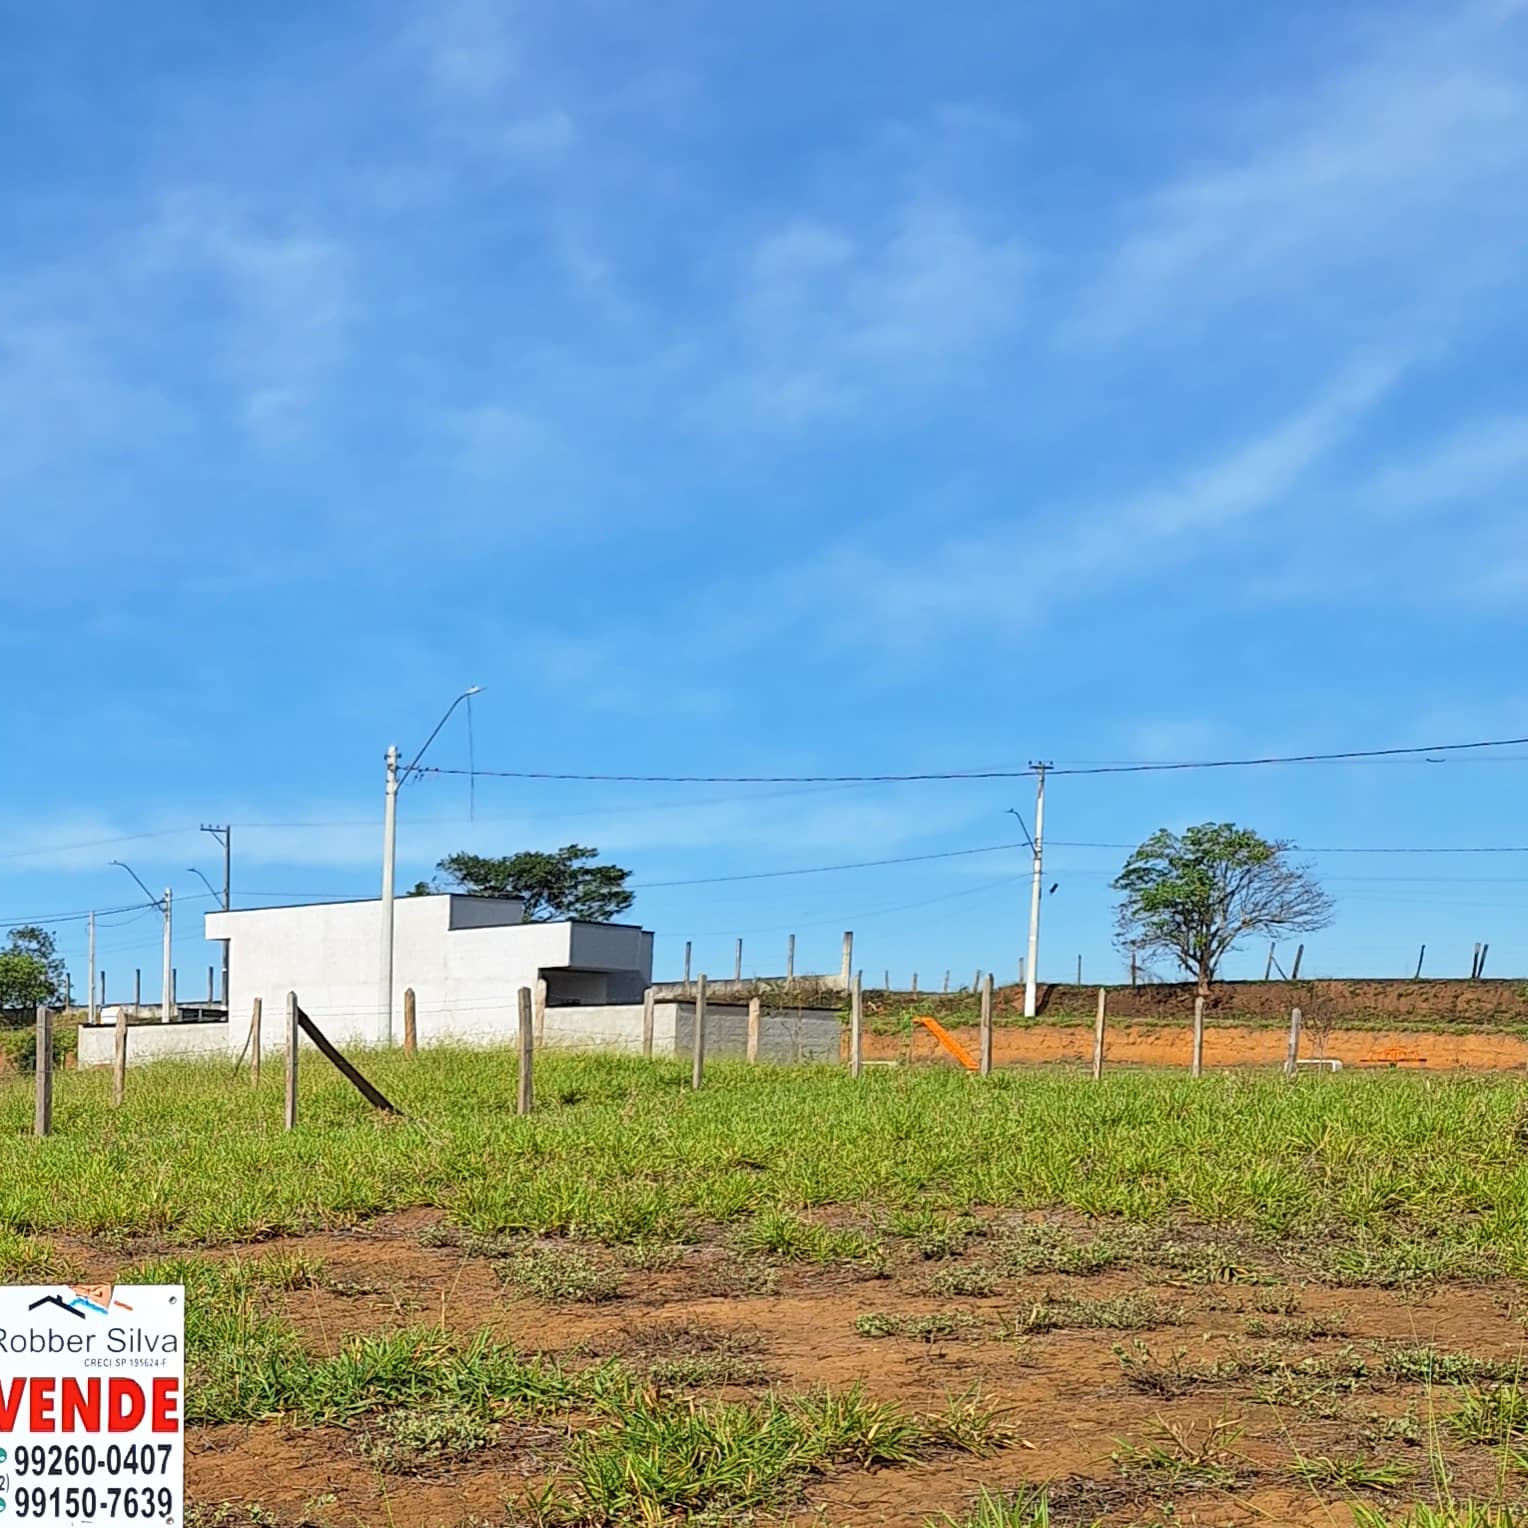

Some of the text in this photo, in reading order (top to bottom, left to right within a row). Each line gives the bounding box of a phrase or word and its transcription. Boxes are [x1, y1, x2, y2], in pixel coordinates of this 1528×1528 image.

[106, 1328, 178, 1353] Silva
[84, 1358, 112, 1367] CRECI
[115, 1358, 127, 1367] SP
[14, 1444, 172, 1476] 99260-0407
[14, 1487, 173, 1518] 99150-7639
